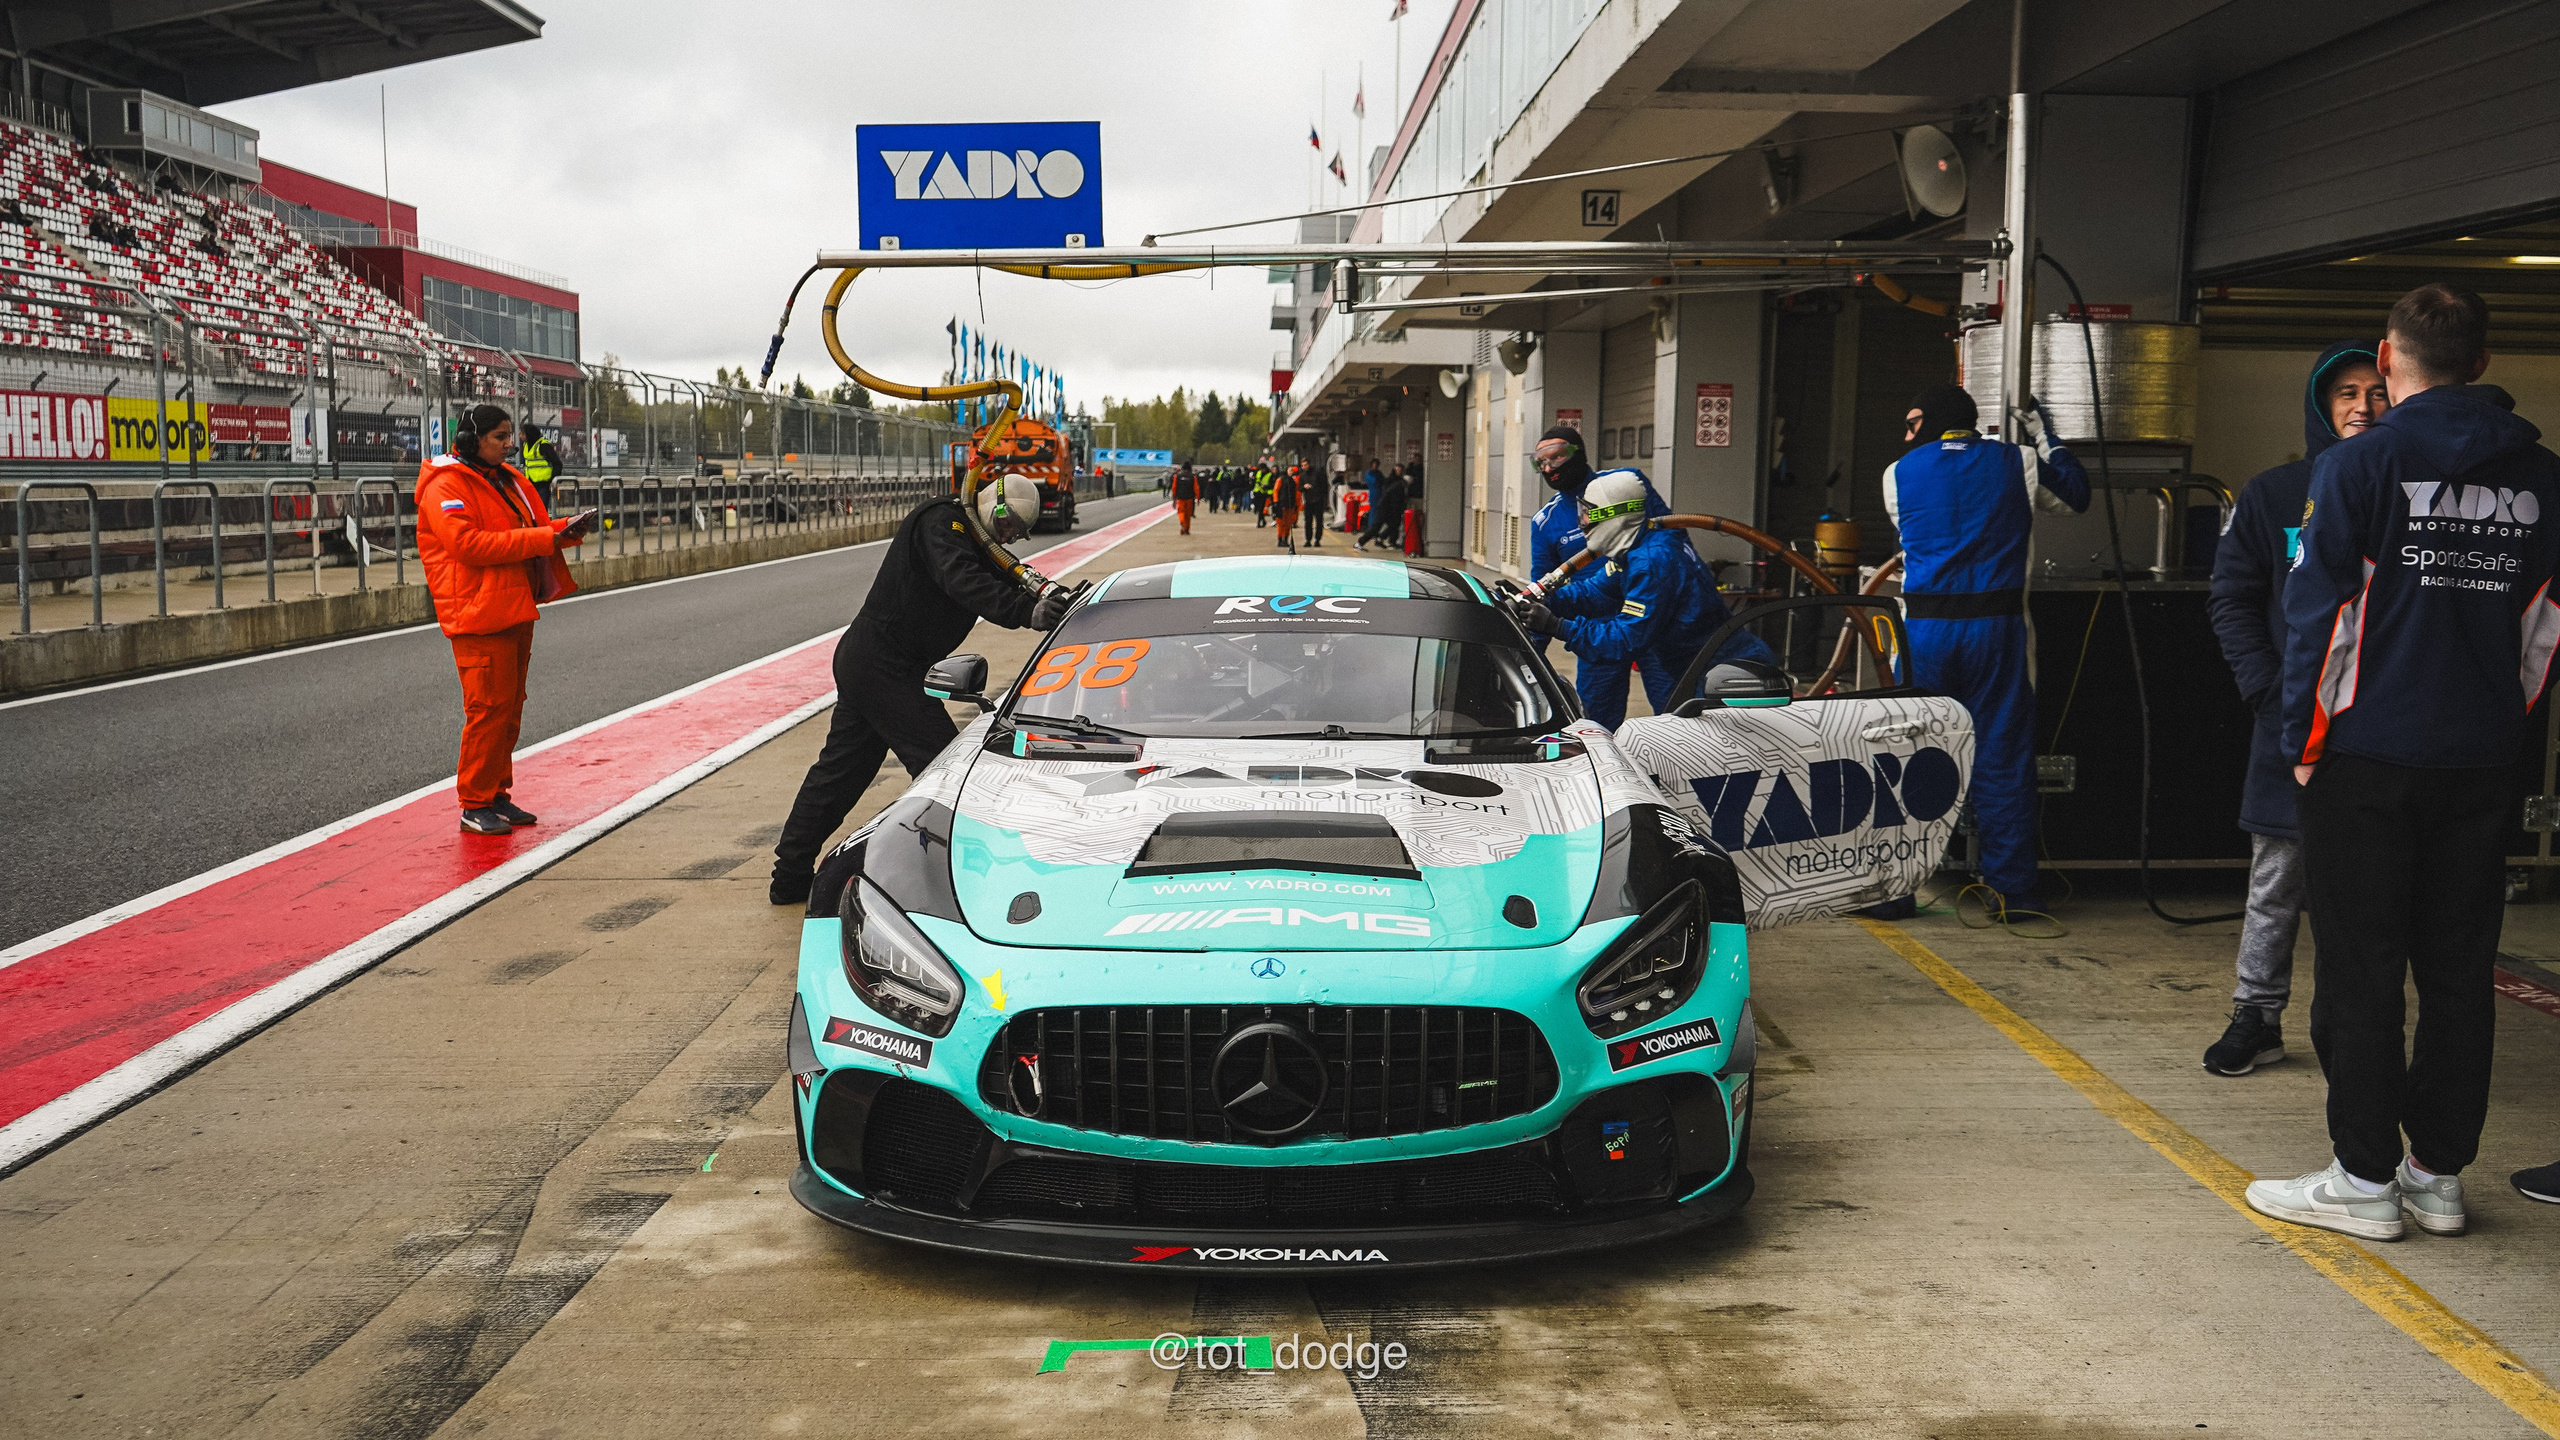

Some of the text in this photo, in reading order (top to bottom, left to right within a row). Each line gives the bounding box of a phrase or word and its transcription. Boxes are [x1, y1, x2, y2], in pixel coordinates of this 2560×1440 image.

[879, 149, 1086, 200] YADRO
[1587, 196, 1614, 221] 14
[0, 394, 105, 459] HELLO!
[110, 415, 190, 450] moor
[337, 429, 357, 445] ТАРТ
[2400, 481, 2540, 525] YADRO
[2408, 521, 2532, 538] MOTORSPORT
[2420, 576, 2511, 592] RACING ACADEMY
[1020, 639, 1151, 696] 88
[1260, 790, 1511, 816] motorsport
[1688, 746, 1960, 853] YADRO
[1786, 836, 1929, 877] motorsport
[1153, 879, 1391, 897] WWW. YADRO.COM
[1208, 907, 1431, 937] AMG
[849, 1027, 921, 1061] YOKOHAMA
[1640, 1025, 1714, 1056] YOKOHAMA
[1193, 1248, 1390, 1263] YOKOHAMA
